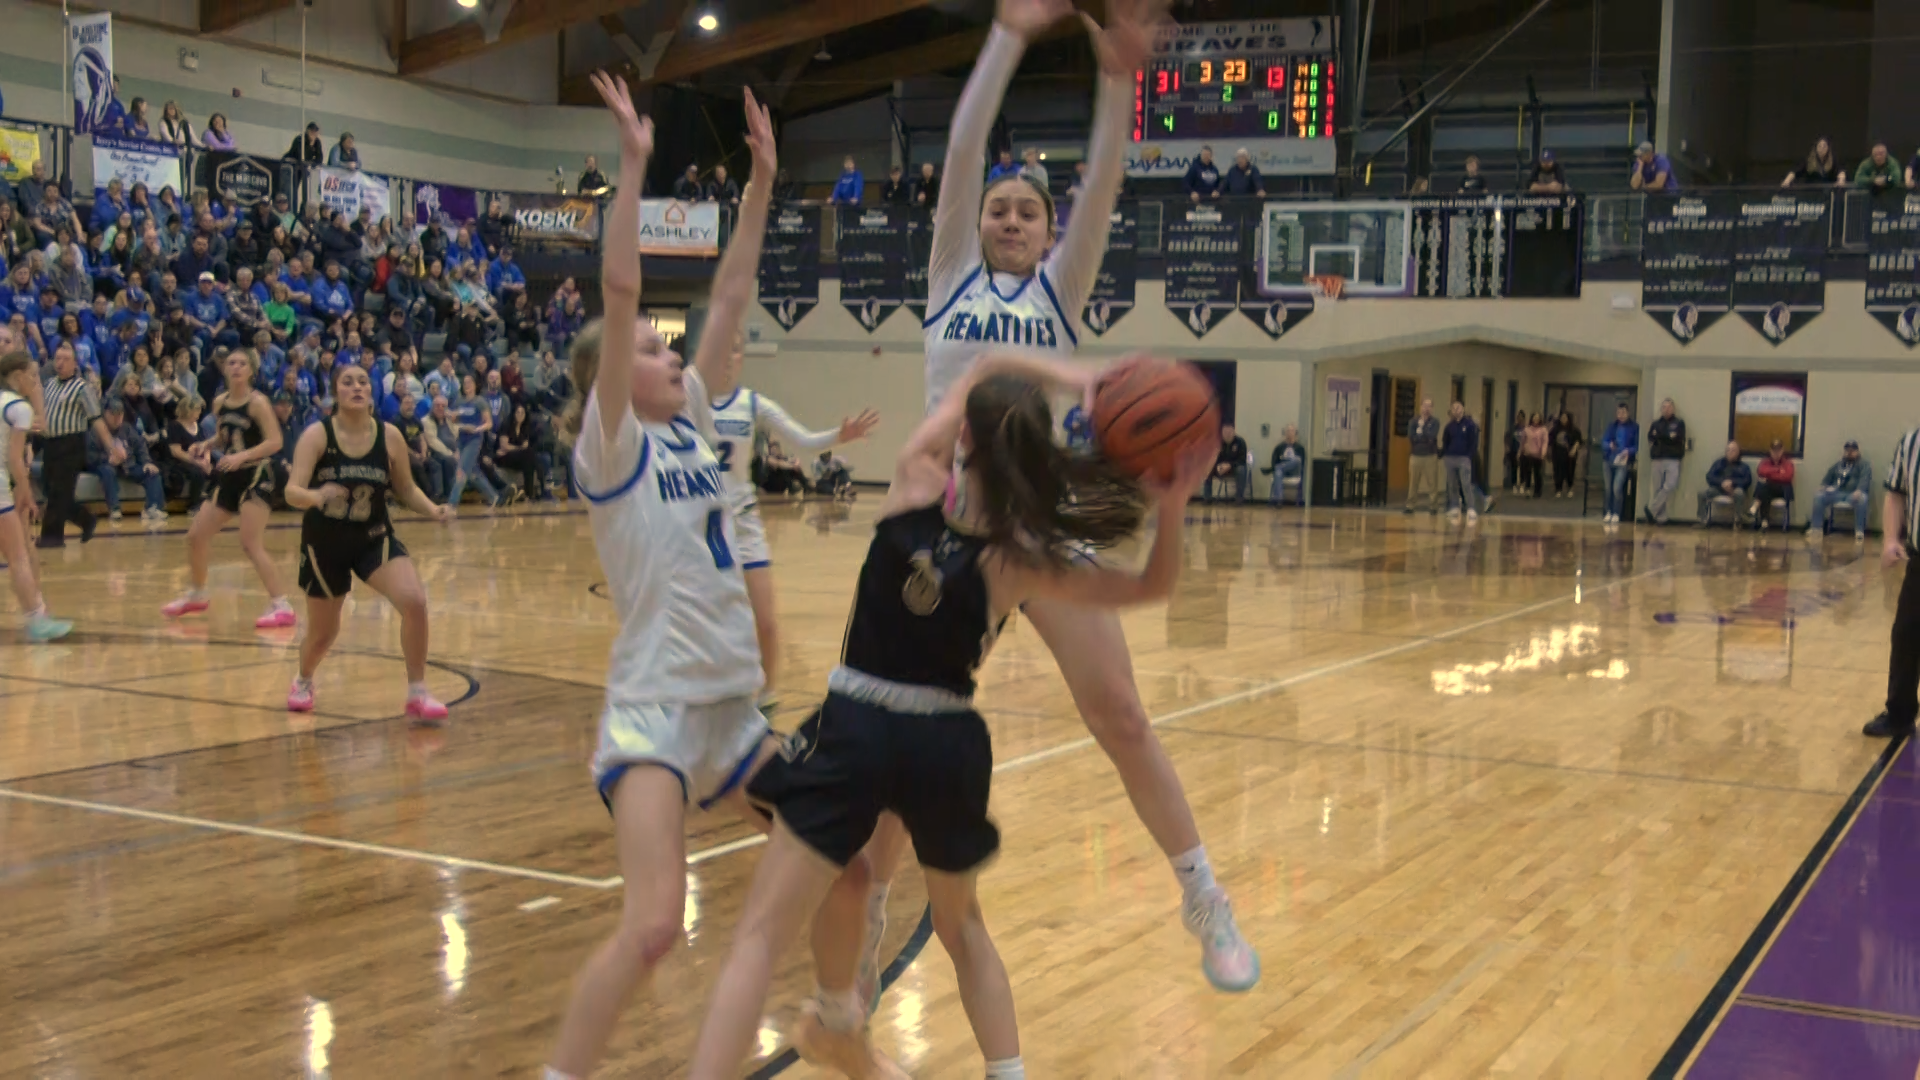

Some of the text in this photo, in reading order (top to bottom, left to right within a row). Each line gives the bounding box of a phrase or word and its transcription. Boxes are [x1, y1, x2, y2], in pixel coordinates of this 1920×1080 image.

[1156, 69, 1179, 93] 31
[1200, 60, 1212, 83] 3
[1223, 59, 1246, 82] 23
[1266, 66, 1285, 89] 13
[1163, 114, 1174, 132] 4
[1267, 111, 1278, 130] 0
[515, 208, 577, 232] KOSKI
[640, 223, 711, 240] ASHLEY
[943, 311, 1057, 347] HEMATITES
